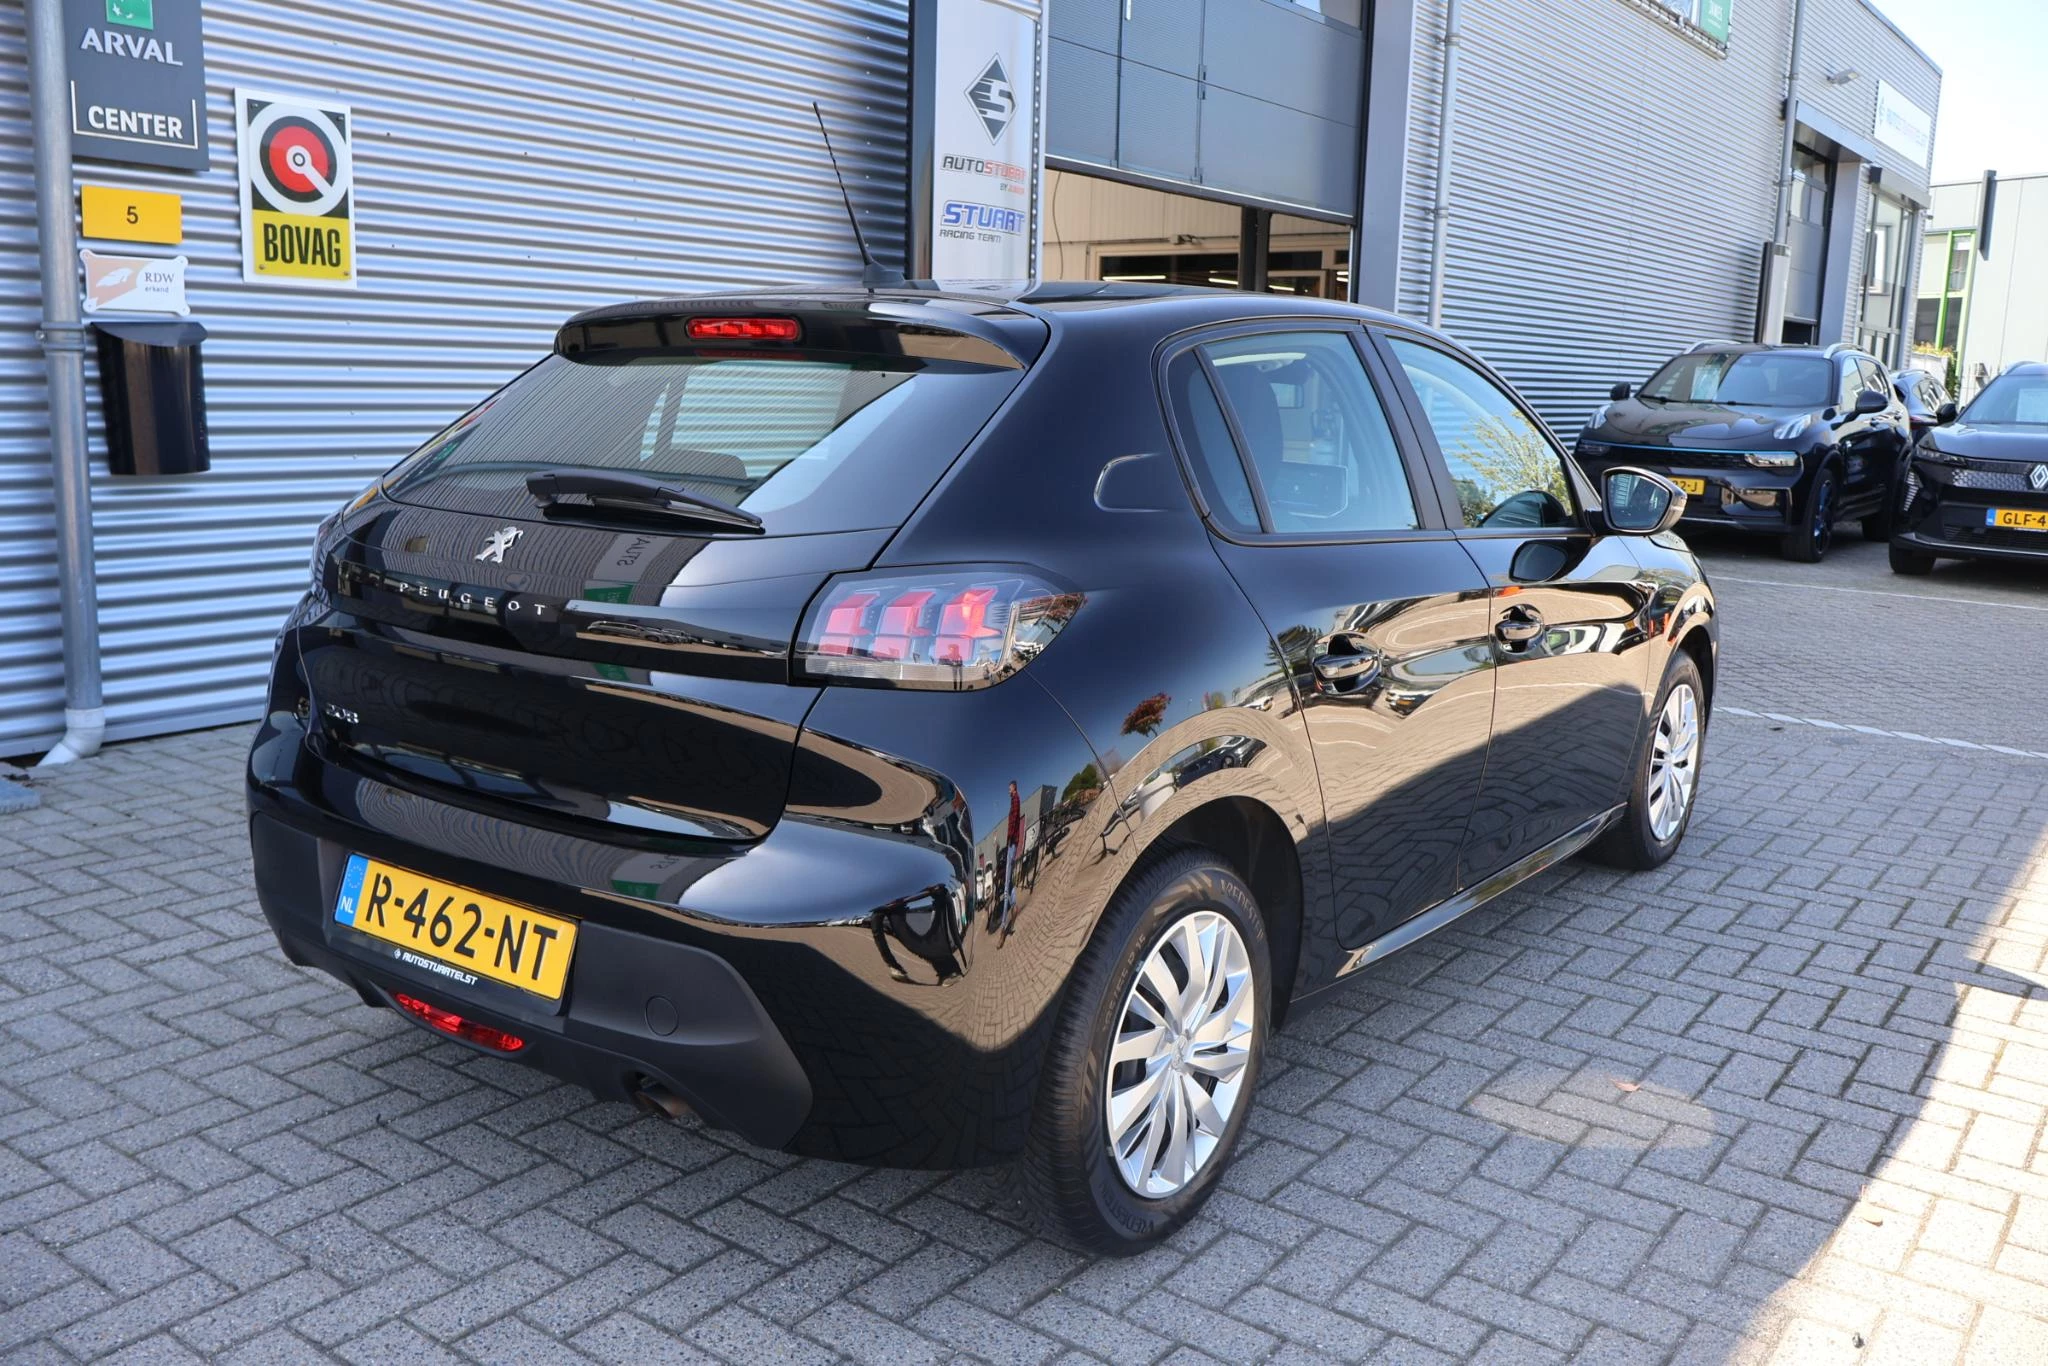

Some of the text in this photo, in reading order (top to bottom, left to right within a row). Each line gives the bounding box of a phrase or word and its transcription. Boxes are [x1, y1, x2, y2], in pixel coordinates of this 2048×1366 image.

[81, 28, 183, 66] ARVAL
[88, 105, 183, 139] CENTER
[126, 206, 138, 224] 5
[943, 203, 1025, 232] STUART
[263, 223, 341, 267] BOVAG
[940, 229, 1002, 243] RACING TEAM
[145, 272, 175, 283] RDW
[399, 582, 546, 616] PEUGEOT
[340, 896, 354, 914] NL
[365, 872, 558, 981] R-462-NT
